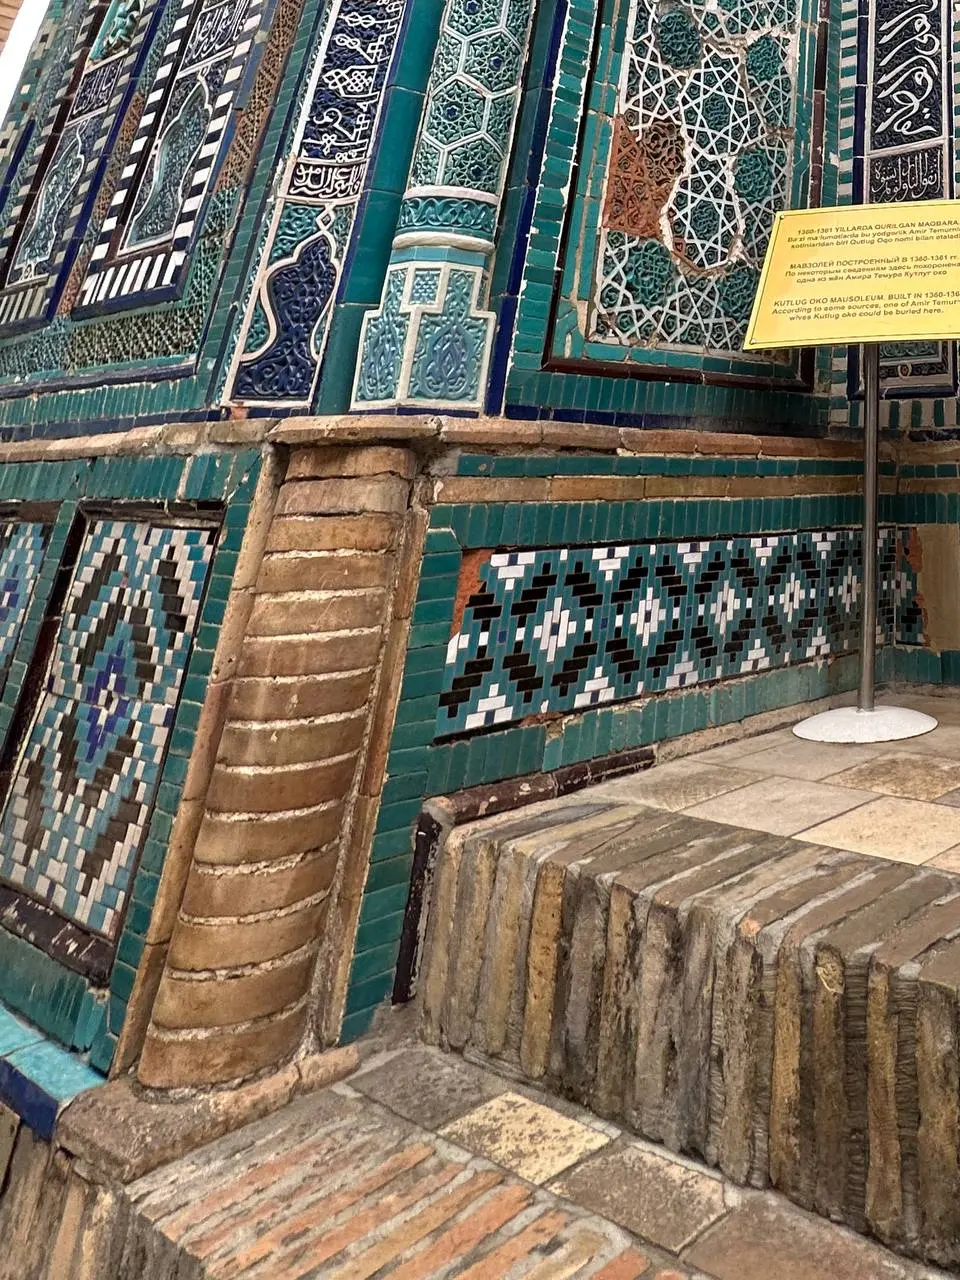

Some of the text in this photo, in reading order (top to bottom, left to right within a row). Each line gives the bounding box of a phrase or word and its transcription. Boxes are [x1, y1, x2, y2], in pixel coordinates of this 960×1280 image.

[790, 261, 834, 269] МАВЗОЛЕЙ
[836, 256, 900, 266] ПОСТРОЕННЫЙ
[774, 299, 807, 307] KUTLUG
[810, 297, 828, 305] OKO
